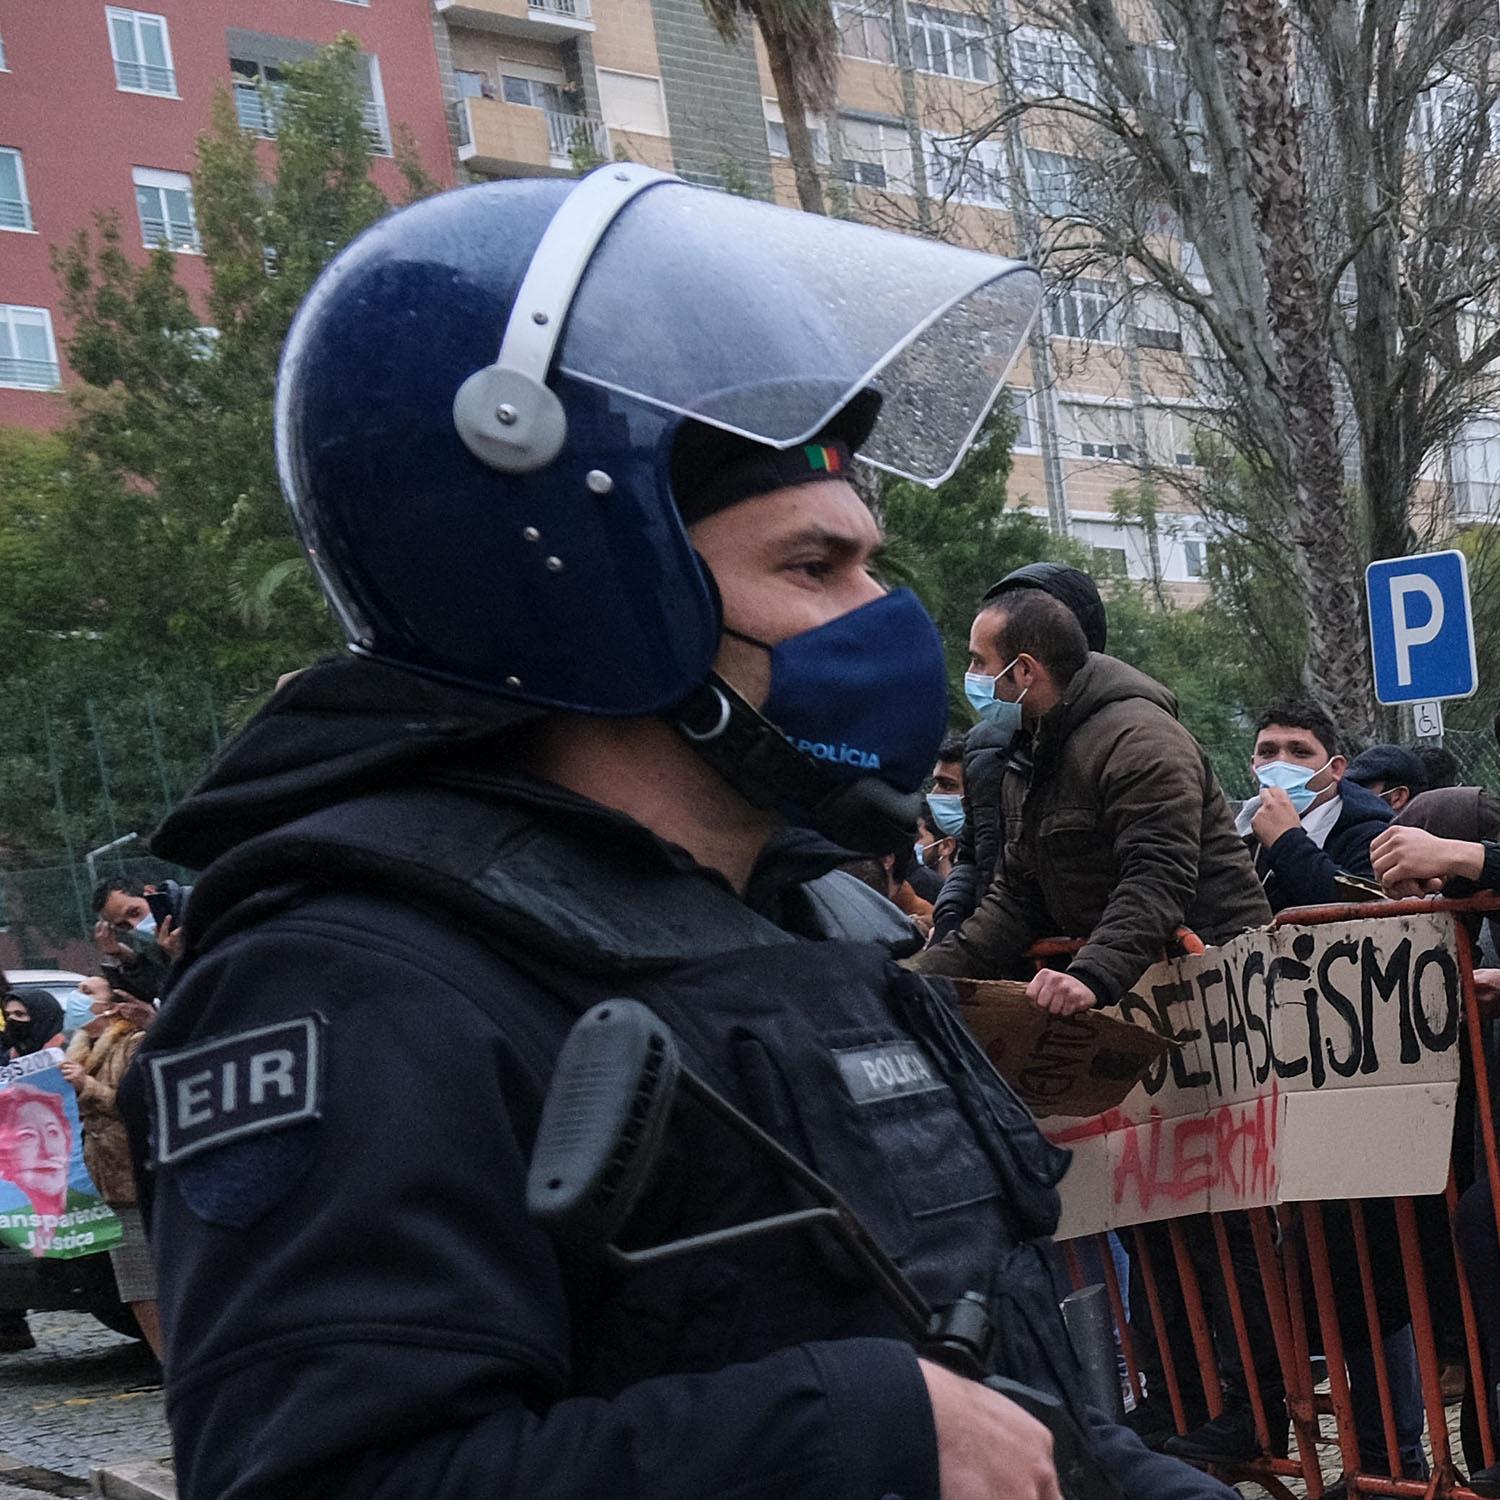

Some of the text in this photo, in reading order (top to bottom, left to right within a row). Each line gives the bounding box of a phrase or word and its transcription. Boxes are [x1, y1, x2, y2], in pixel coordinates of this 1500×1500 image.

[1389, 573, 1445, 687] P
[797, 738, 880, 769] POLÍCIA
[176, 1049, 294, 1130] EIR
